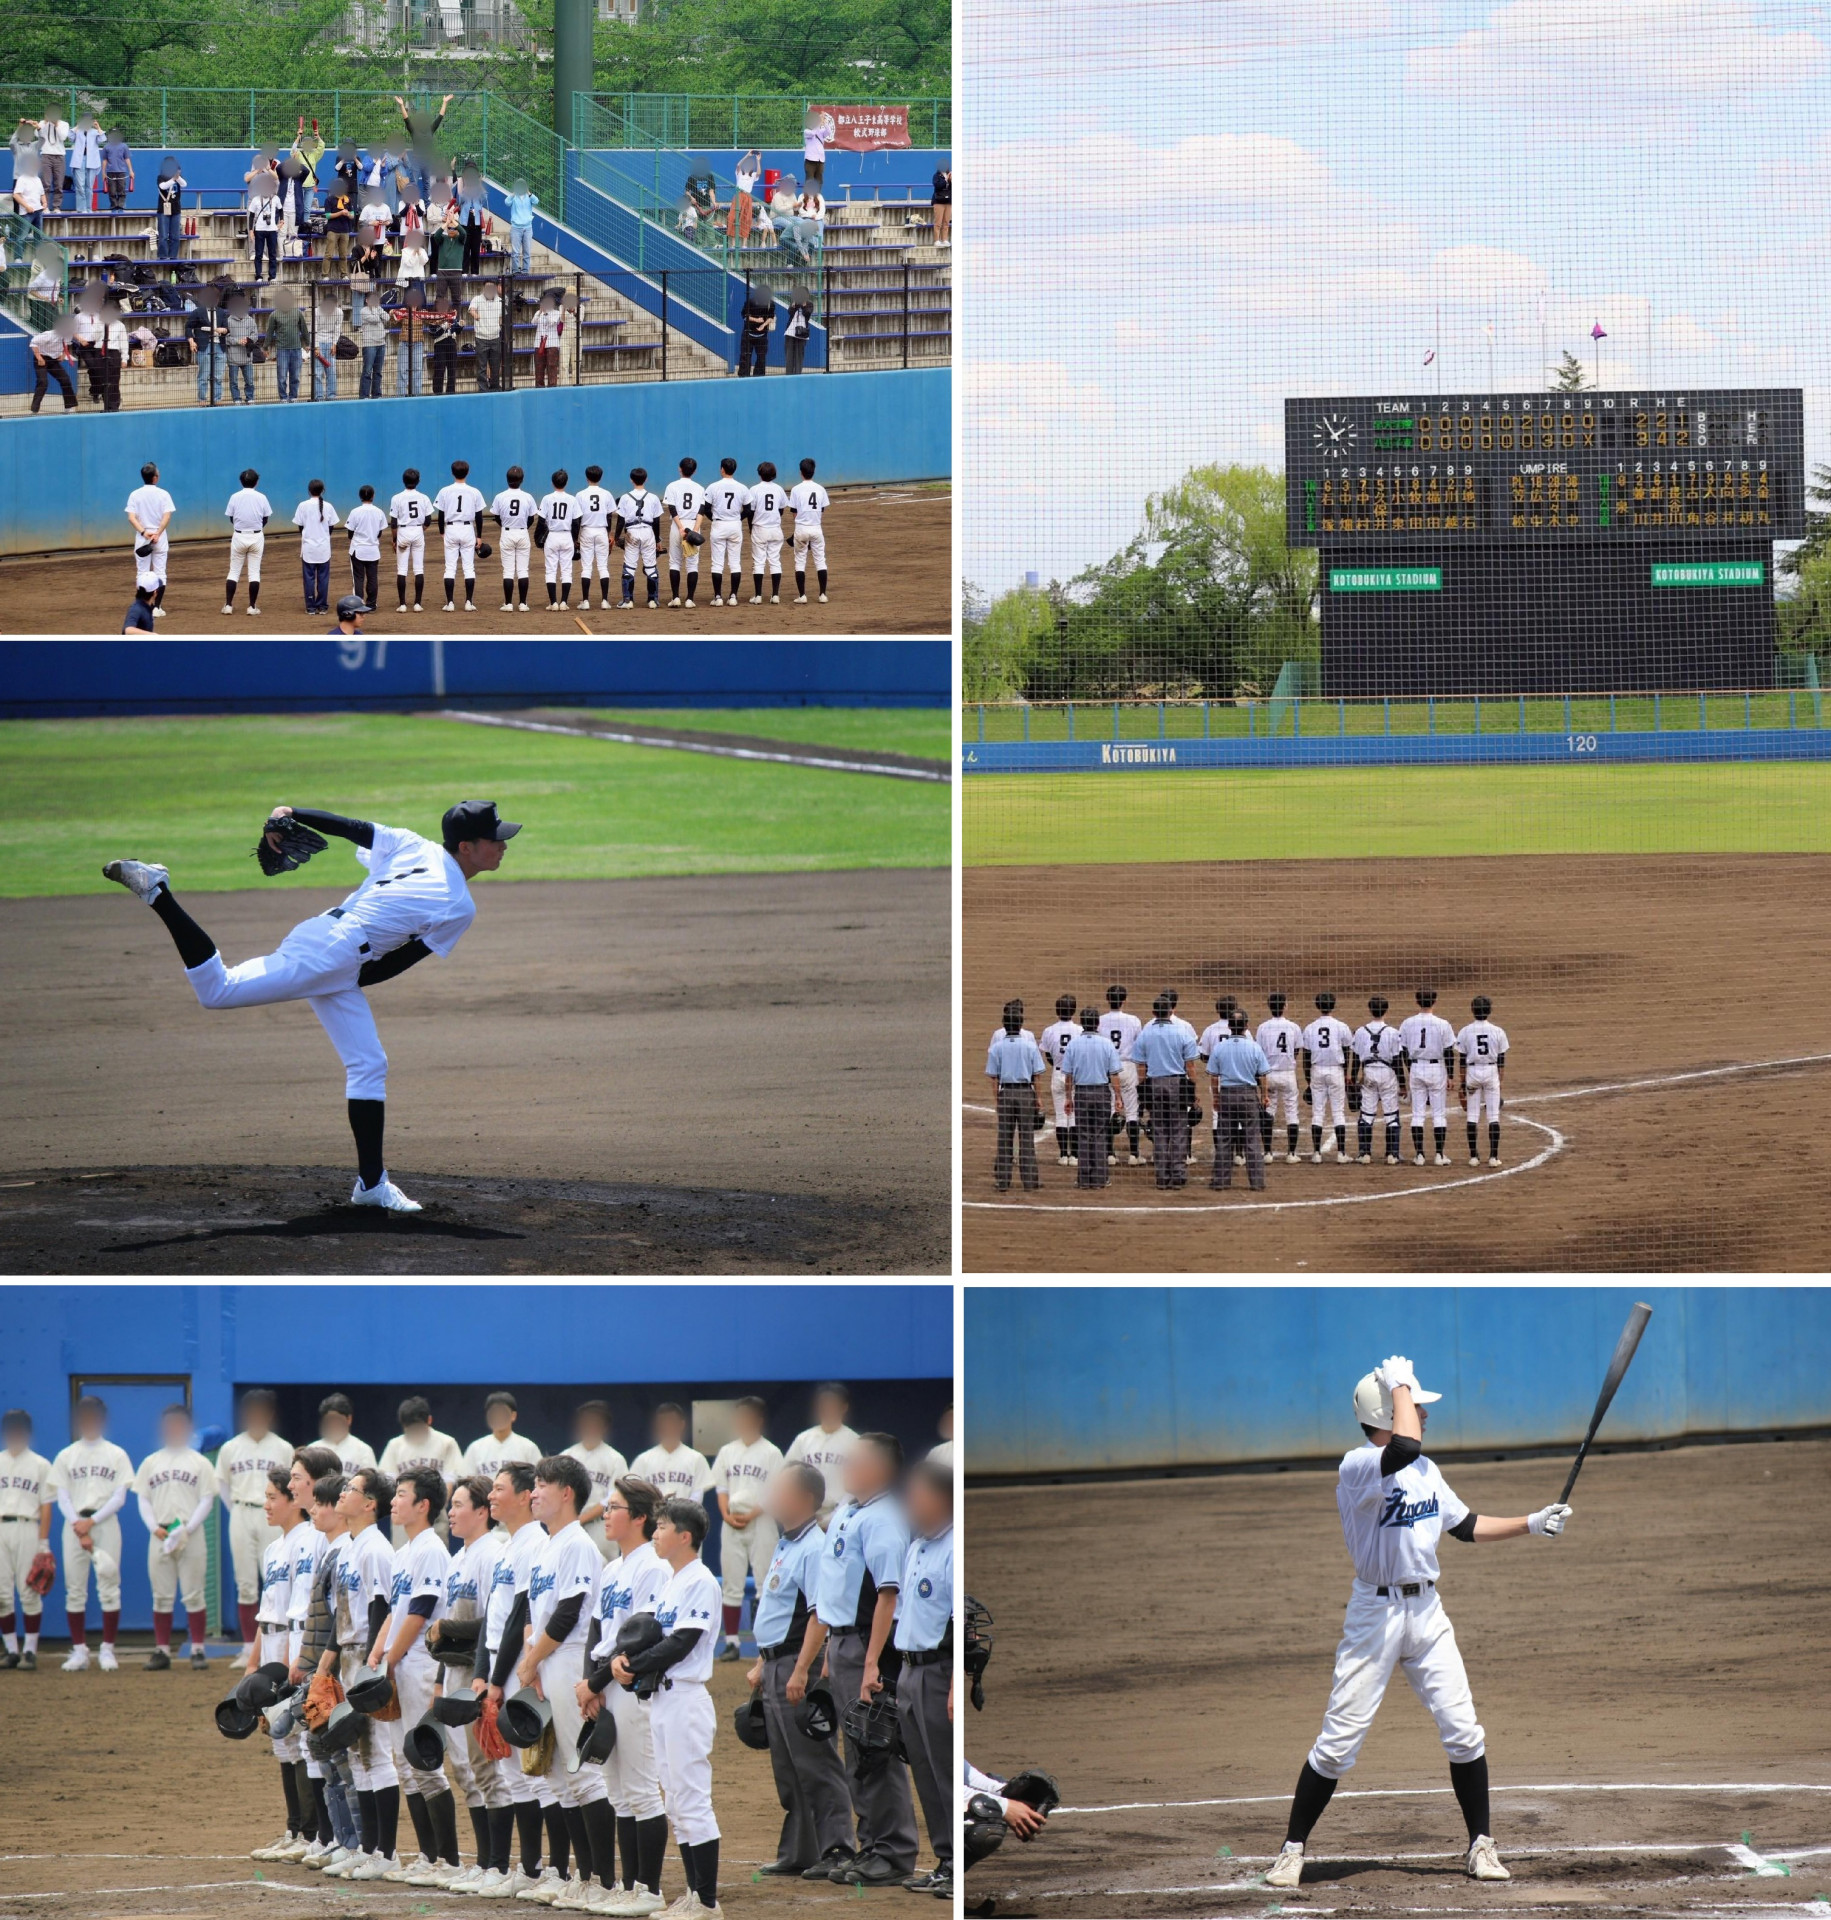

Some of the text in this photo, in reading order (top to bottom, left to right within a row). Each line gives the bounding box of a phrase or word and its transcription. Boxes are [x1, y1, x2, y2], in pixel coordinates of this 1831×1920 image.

[1376, 397, 1686, 413] TEAM 1 2 3 4 5 6 7 8 9 10 R H E
[1420, 416, 1431, 432] 0
[1440, 416, 1452, 432] 0
[1461, 416, 1472, 430] 0
[1480, 416, 1492, 430] 0
[1501, 415, 1512, 430] 0
[1522, 415, 1532, 428] 2
[1542, 414, 1554, 430] 0
[1562, 414, 1574, 428] 0
[1582, 414, 1593, 428] 0
[1636, 413, 1646, 427] 2
[1656, 412, 1667, 426] 2
[1678, 412, 1685, 426] 1
[1698, 412, 1706, 422] B
[1748, 412, 1756, 421] H
[1698, 424, 1706, 433] S
[1748, 424, 1756, 433] E
[1420, 435, 1432, 450] 0
[1440, 434, 1452, 450] 0
[1461, 434, 1472, 449] 0
[1481, 434, 1492, 448] 0
[1501, 434, 1512, 448] 0
[1522, 434, 1533, 448] 0
[1542, 434, 1554, 448] 3
[1562, 433, 1574, 447] 0
[1636, 432, 1648, 446] 3
[1656, 432, 1668, 446] 4
[1676, 432, 1688, 446] 2
[1324, 466, 1472, 478] 1 2 3 4 5 6 7 8 9
[1520, 462, 1568, 474] UMPIRE
[1618, 460, 1767, 472] 1 2 3 4 5 6 7 8 9
[408, 501, 418, 519] 5
[456, 495, 463, 513] 1
[510, 499, 520, 517] 9
[590, 494, 600, 512] 3
[682, 492, 693, 510] 8
[724, 492, 735, 510] 7
[764, 494, 774, 511] 6
[808, 492, 818, 510] 4
[552, 502, 568, 520] 10
[1333, 573, 1437, 586] KOTOBUKIYA STADIUM
[1656, 568, 1760, 581] KOTOBUKIYA STADIUM
[1567, 736, 1597, 752] 120
[1102, 744, 1176, 764] KOTOBUKIYA
[1060, 1034, 1072, 1054] 9
[1110, 1030, 1122, 1050] 8
[1276, 1032, 1287, 1053] 4
[1318, 1027, 1330, 1048] 3
[1419, 1028, 1427, 1048] 1
[1476, 1034, 1489, 1056] 5
